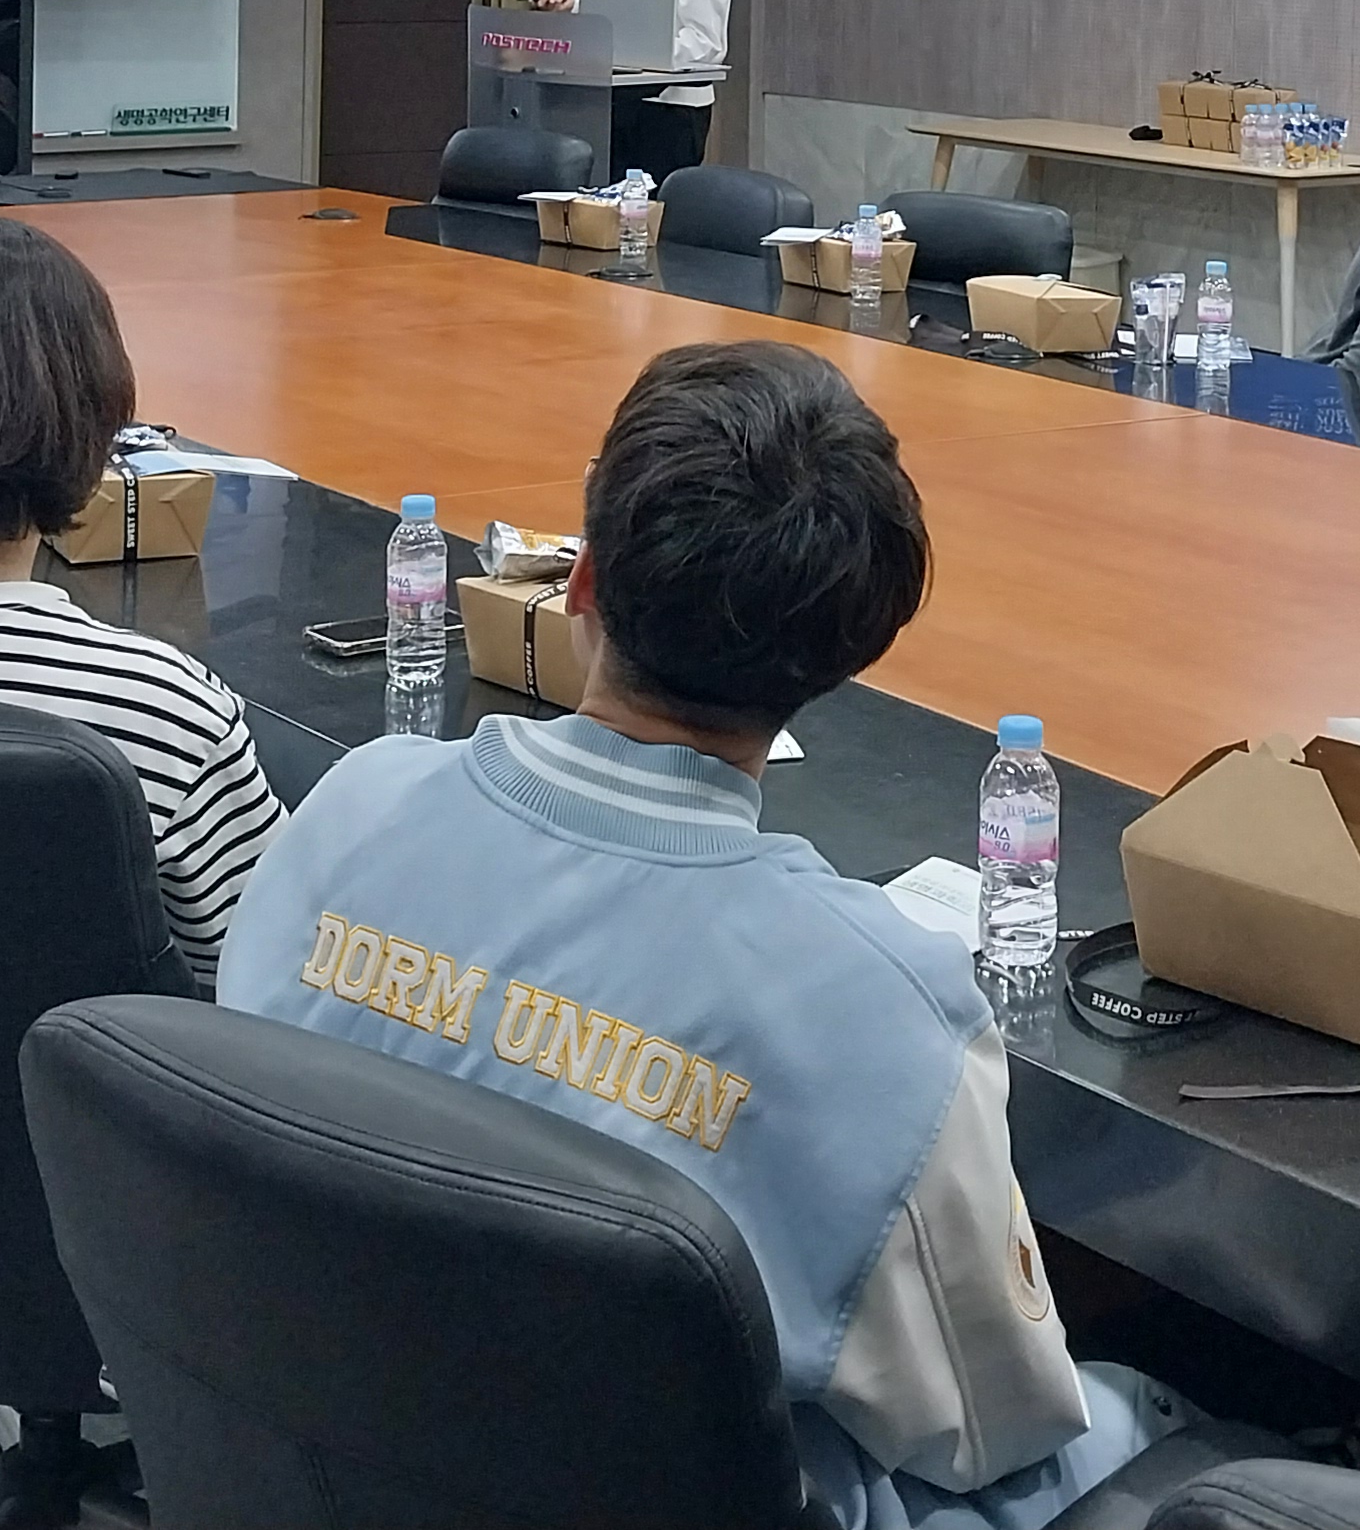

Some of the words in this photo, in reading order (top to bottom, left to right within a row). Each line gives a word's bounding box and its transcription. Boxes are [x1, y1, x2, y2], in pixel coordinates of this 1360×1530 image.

[481, 31, 572, 55] POSTECH
[114, 104, 230, 126] 생명공학연구센터
[1091, 992, 1142, 1019] COFFEE
[300, 911, 489, 1044] DORM
[493, 979, 751, 1152] UNION
